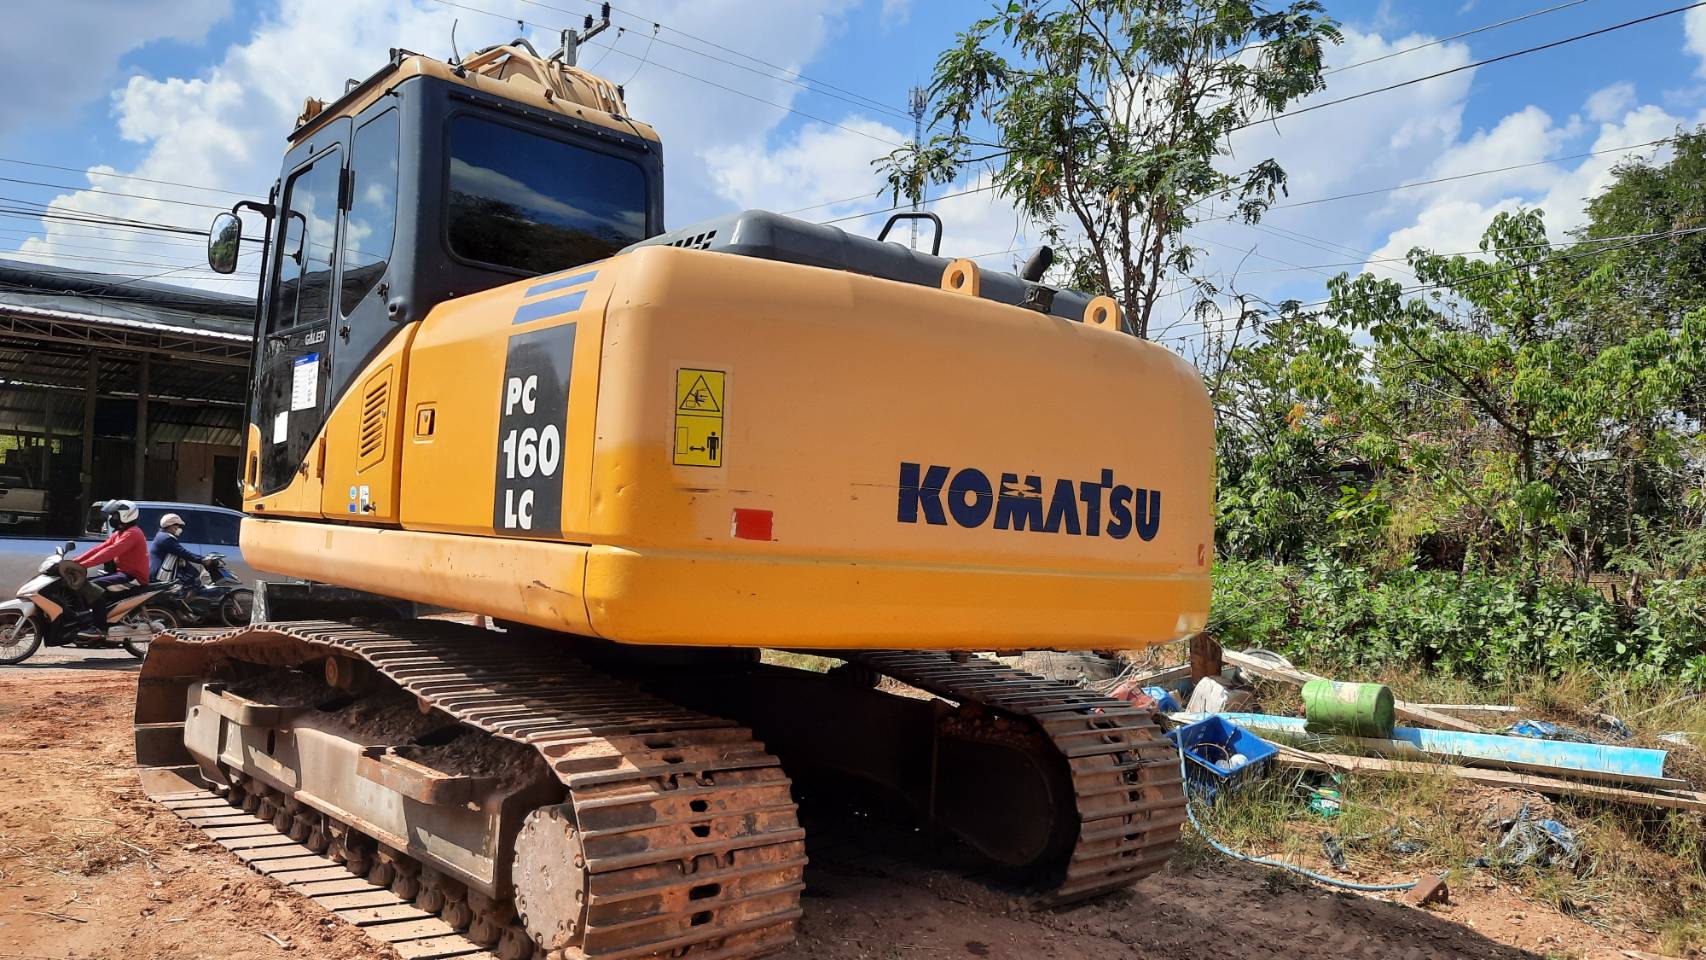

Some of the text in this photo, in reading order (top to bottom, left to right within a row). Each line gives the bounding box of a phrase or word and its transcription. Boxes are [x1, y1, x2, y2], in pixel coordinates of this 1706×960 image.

[505, 375, 538, 416] PC
[503, 424, 560, 479] 160
[504, 489, 534, 530] LC
[897, 462, 1161, 541] KOMATSU
